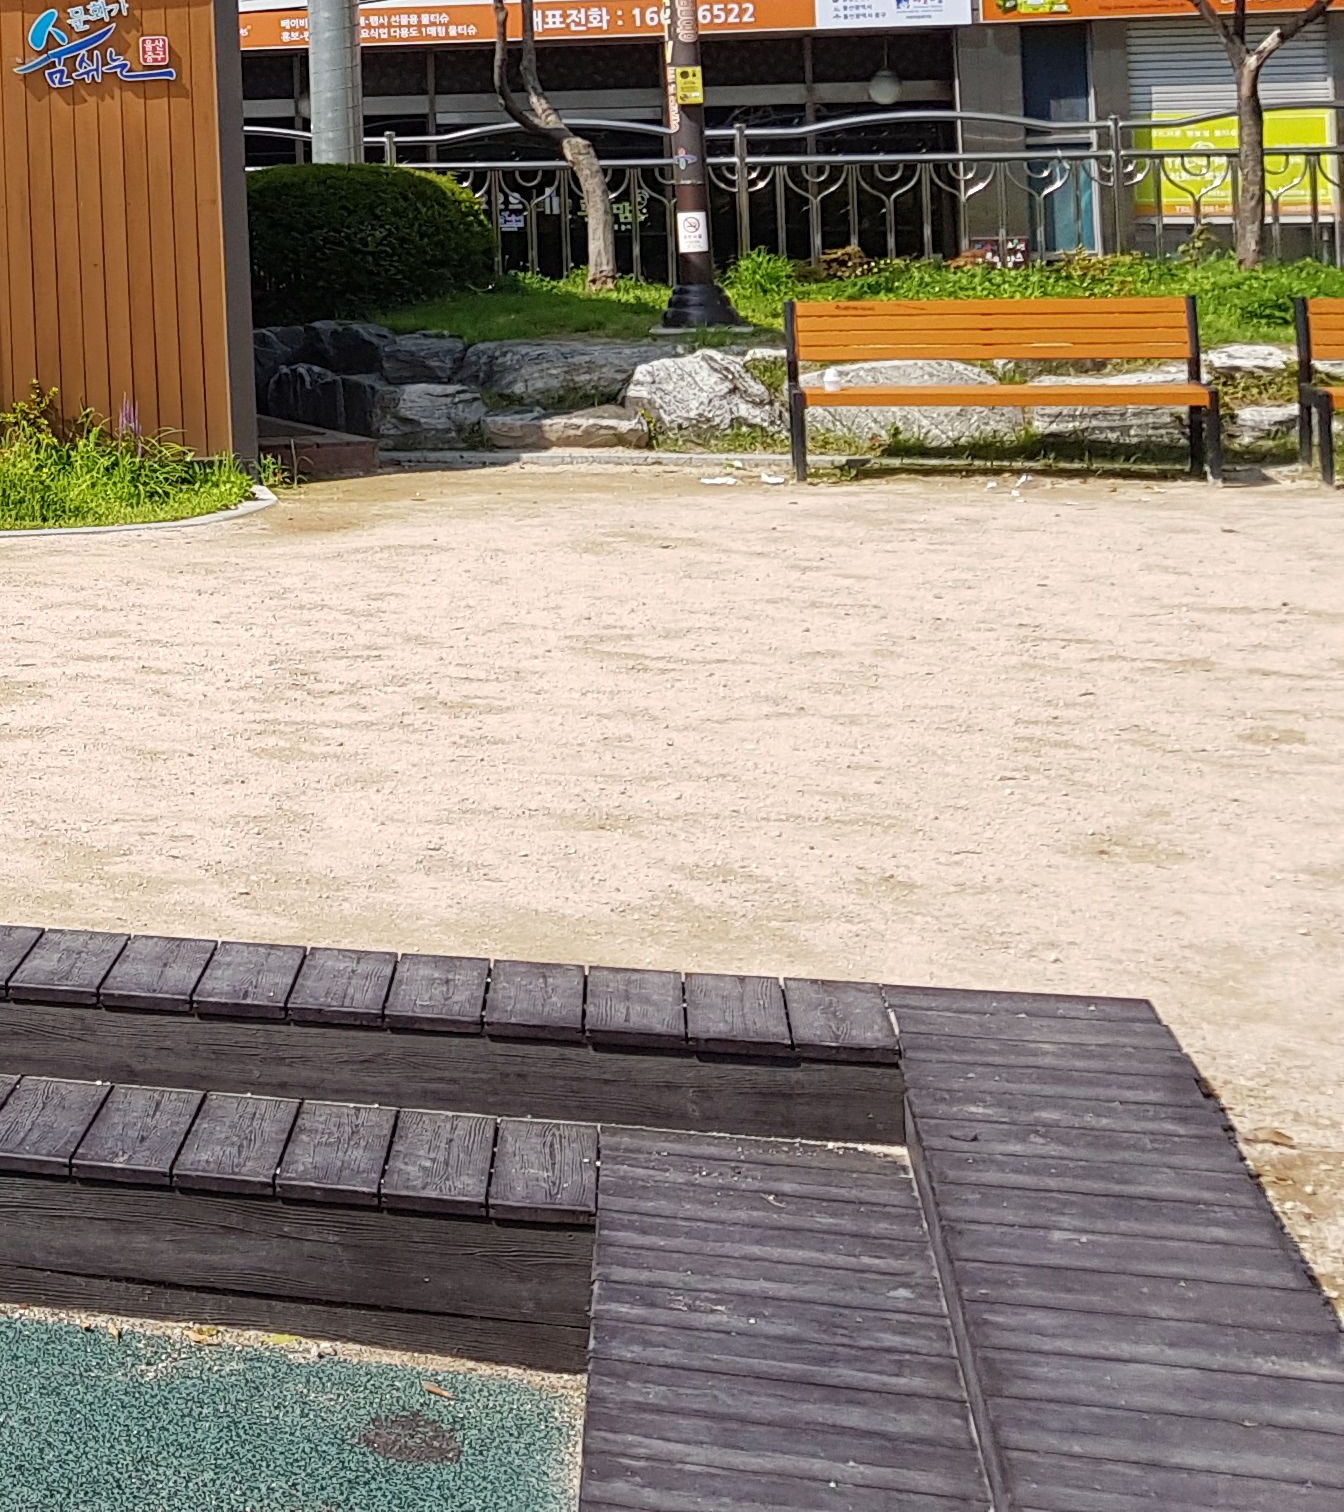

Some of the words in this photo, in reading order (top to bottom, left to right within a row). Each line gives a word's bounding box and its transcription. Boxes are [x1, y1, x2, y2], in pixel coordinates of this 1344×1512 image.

[421, 12, 450, 25] 물티슈
[390, 26, 421, 38] 다용도
[448, 24, 477, 37] 물티슈
